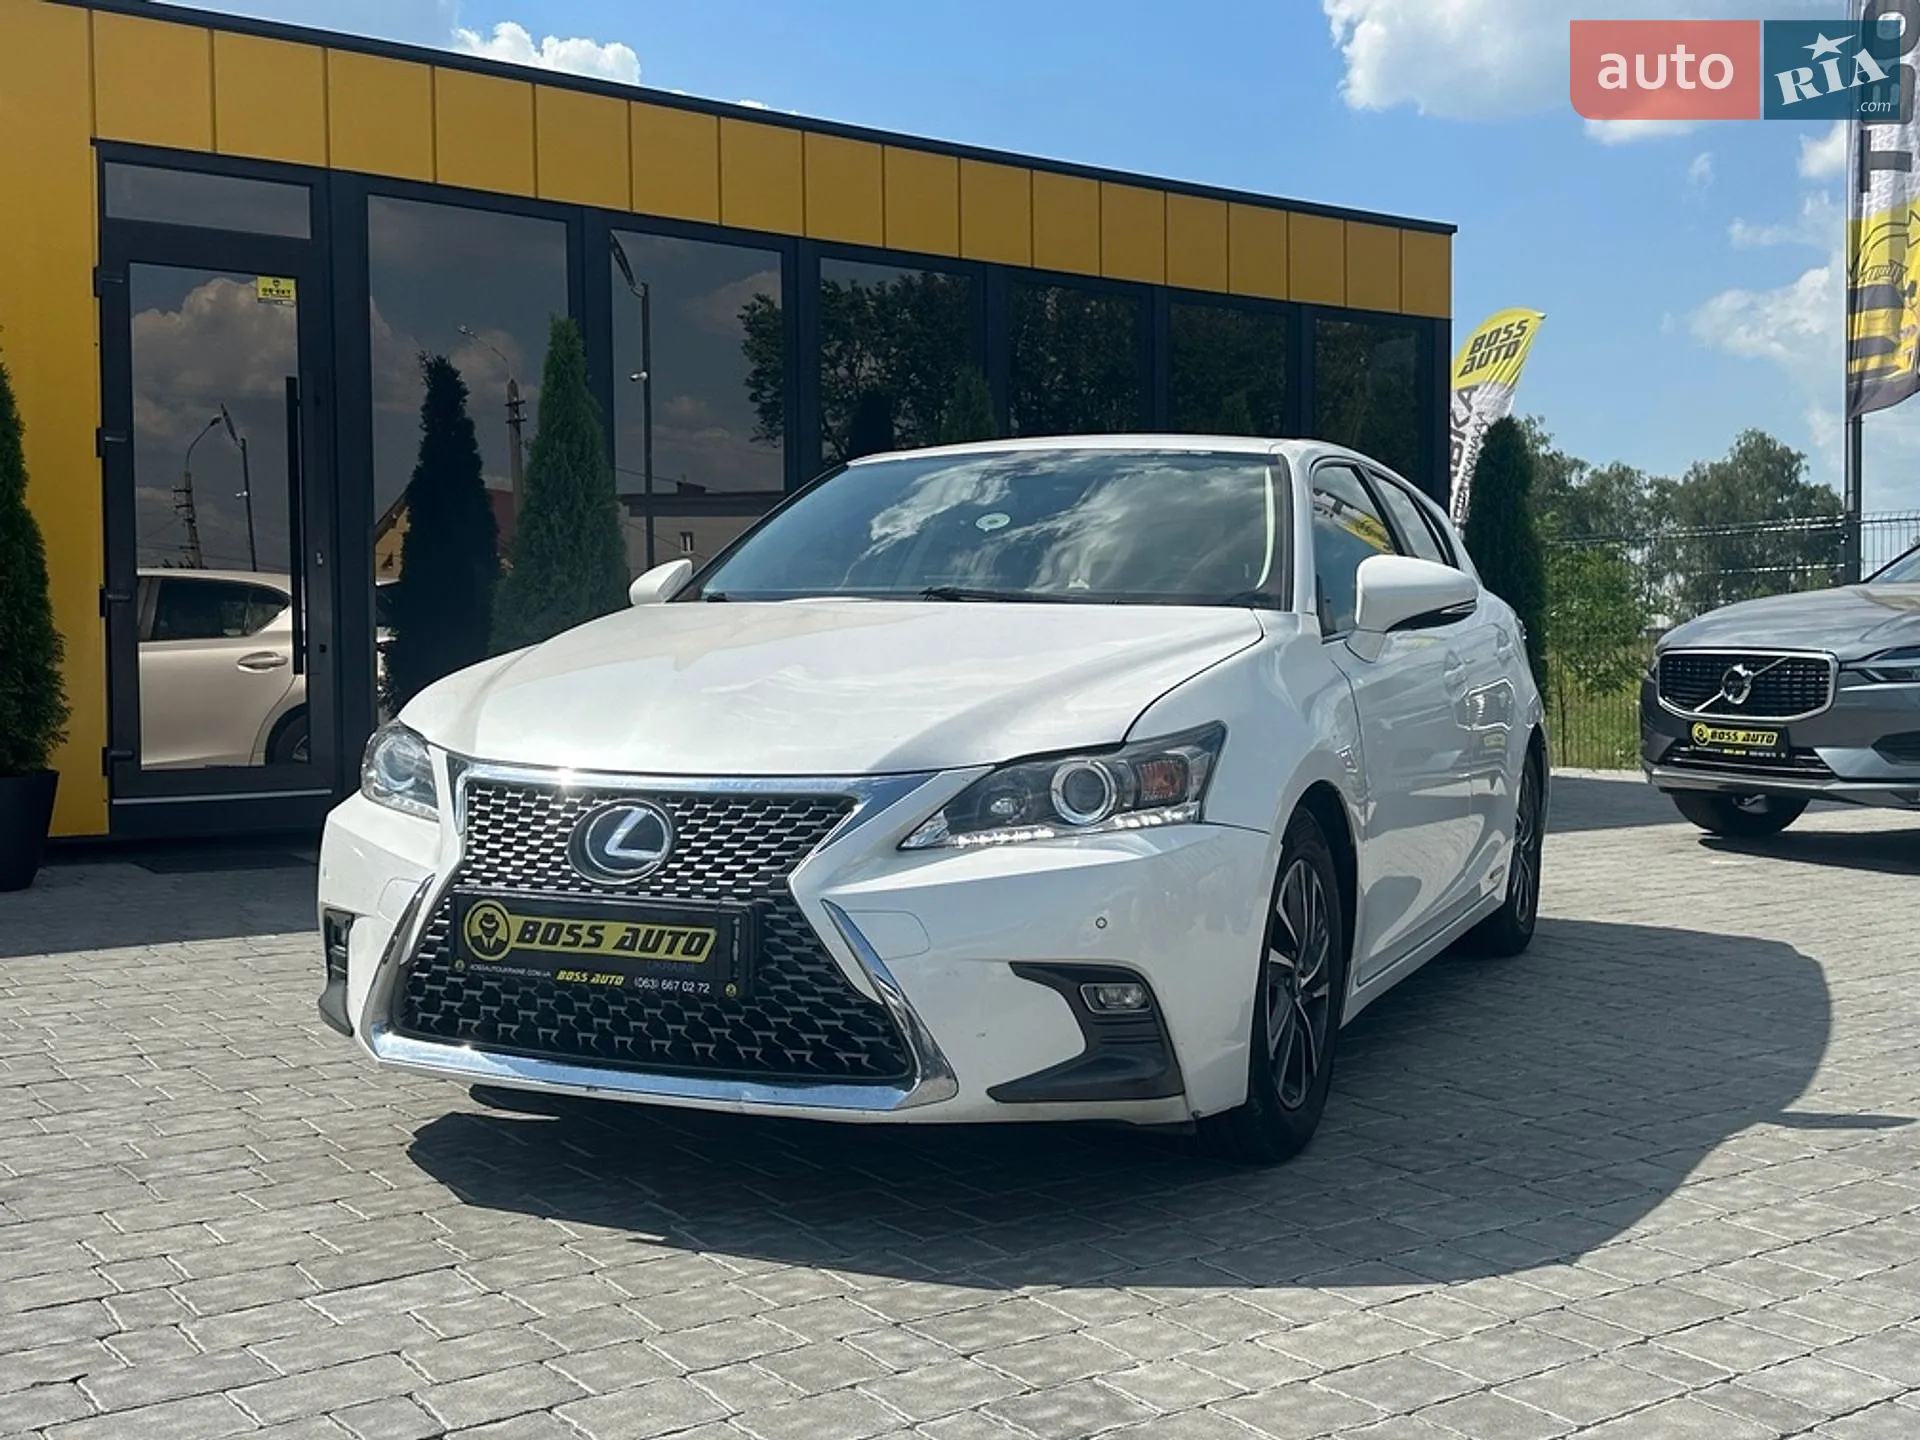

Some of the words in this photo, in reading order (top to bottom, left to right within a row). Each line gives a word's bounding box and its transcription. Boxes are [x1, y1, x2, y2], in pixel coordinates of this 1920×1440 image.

[1469, 319, 1530, 355] BOSS
[1711, 730, 1738, 742] BOSS
[516, 919, 605, 948] BOSS
[612, 926, 711, 956] AUTO
[556, 970, 588, 982] BOSS
[591, 974, 625, 985] AUTO
[661, 979, 680, 991] 667
[682, 981, 695, 992] 02
[697, 982, 710, 994] 72
